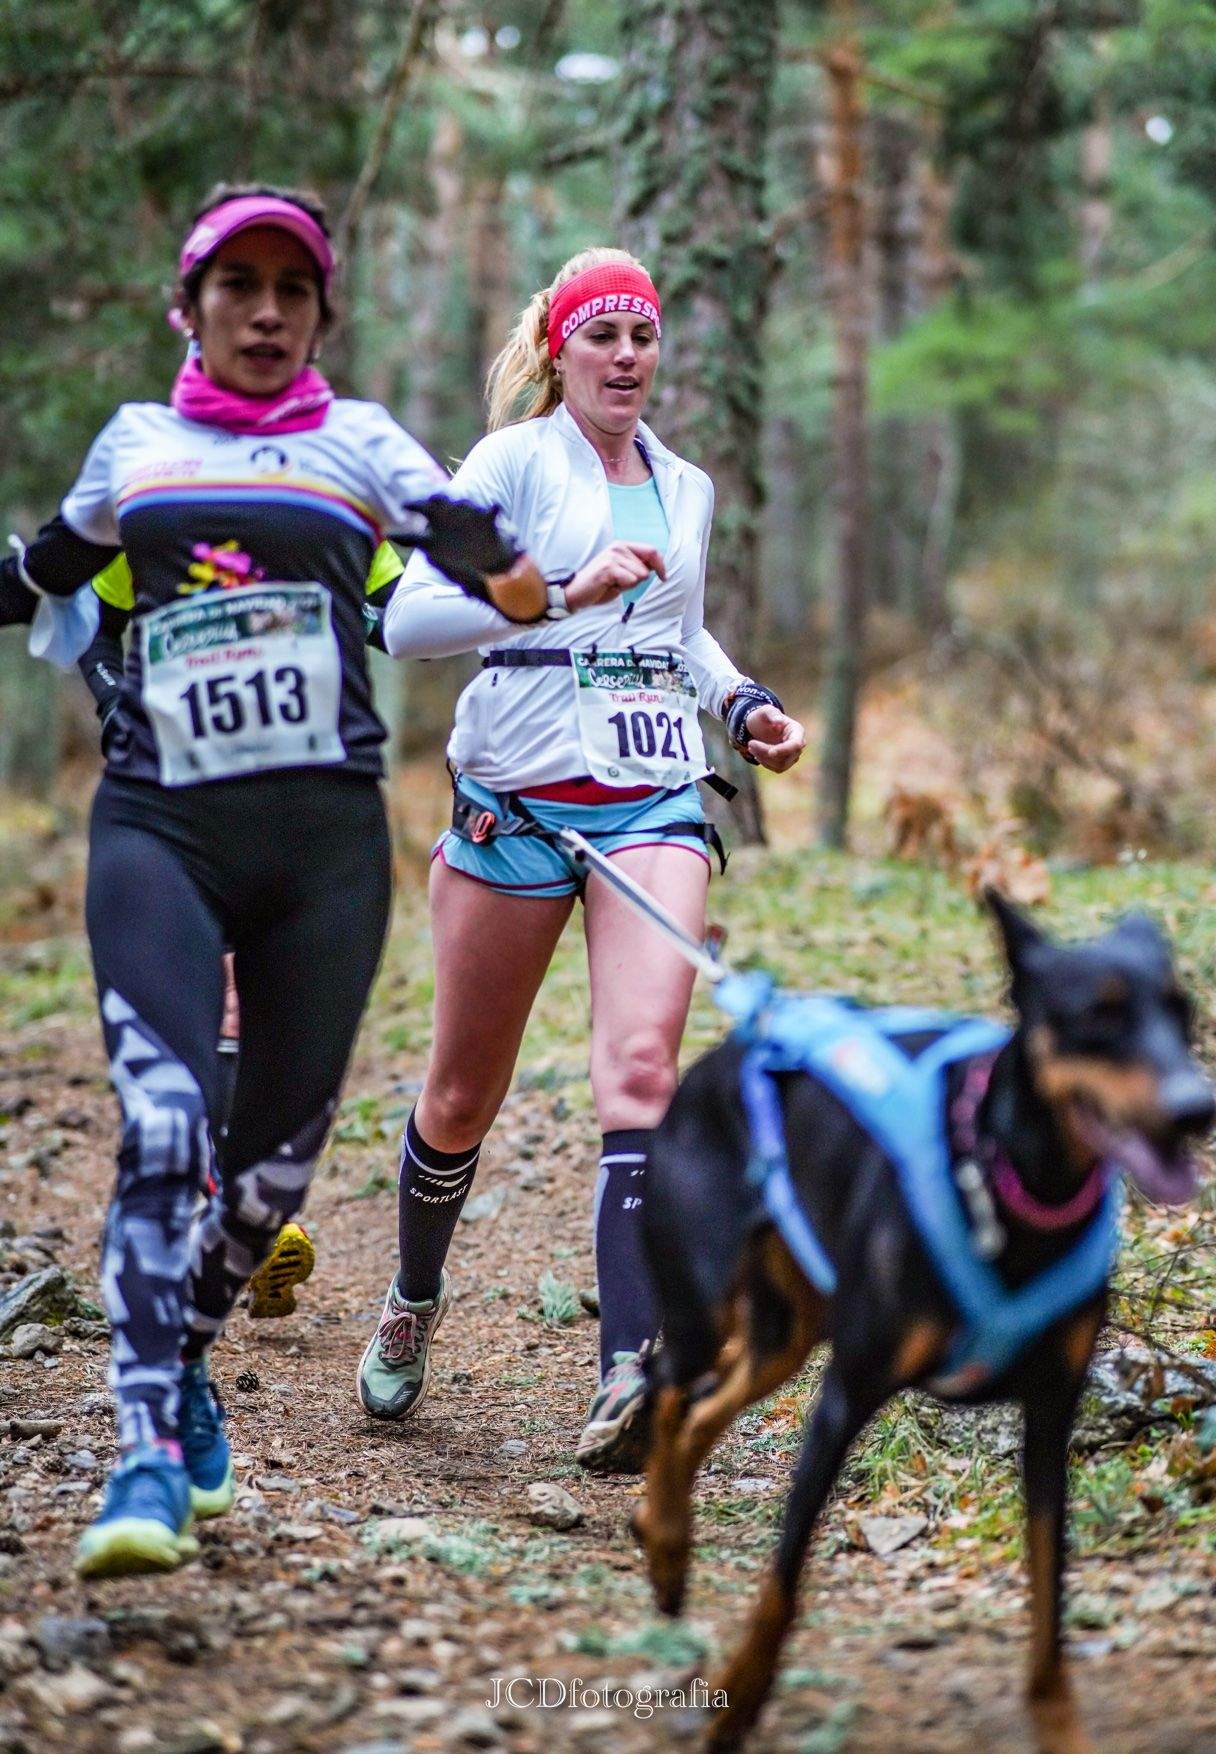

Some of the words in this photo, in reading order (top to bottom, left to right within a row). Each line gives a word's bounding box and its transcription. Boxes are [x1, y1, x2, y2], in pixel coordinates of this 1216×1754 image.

[180, 666, 308, 739] 1513
[608, 710, 691, 763] 1021
[409, 1183, 469, 1203] SPORTLAST
